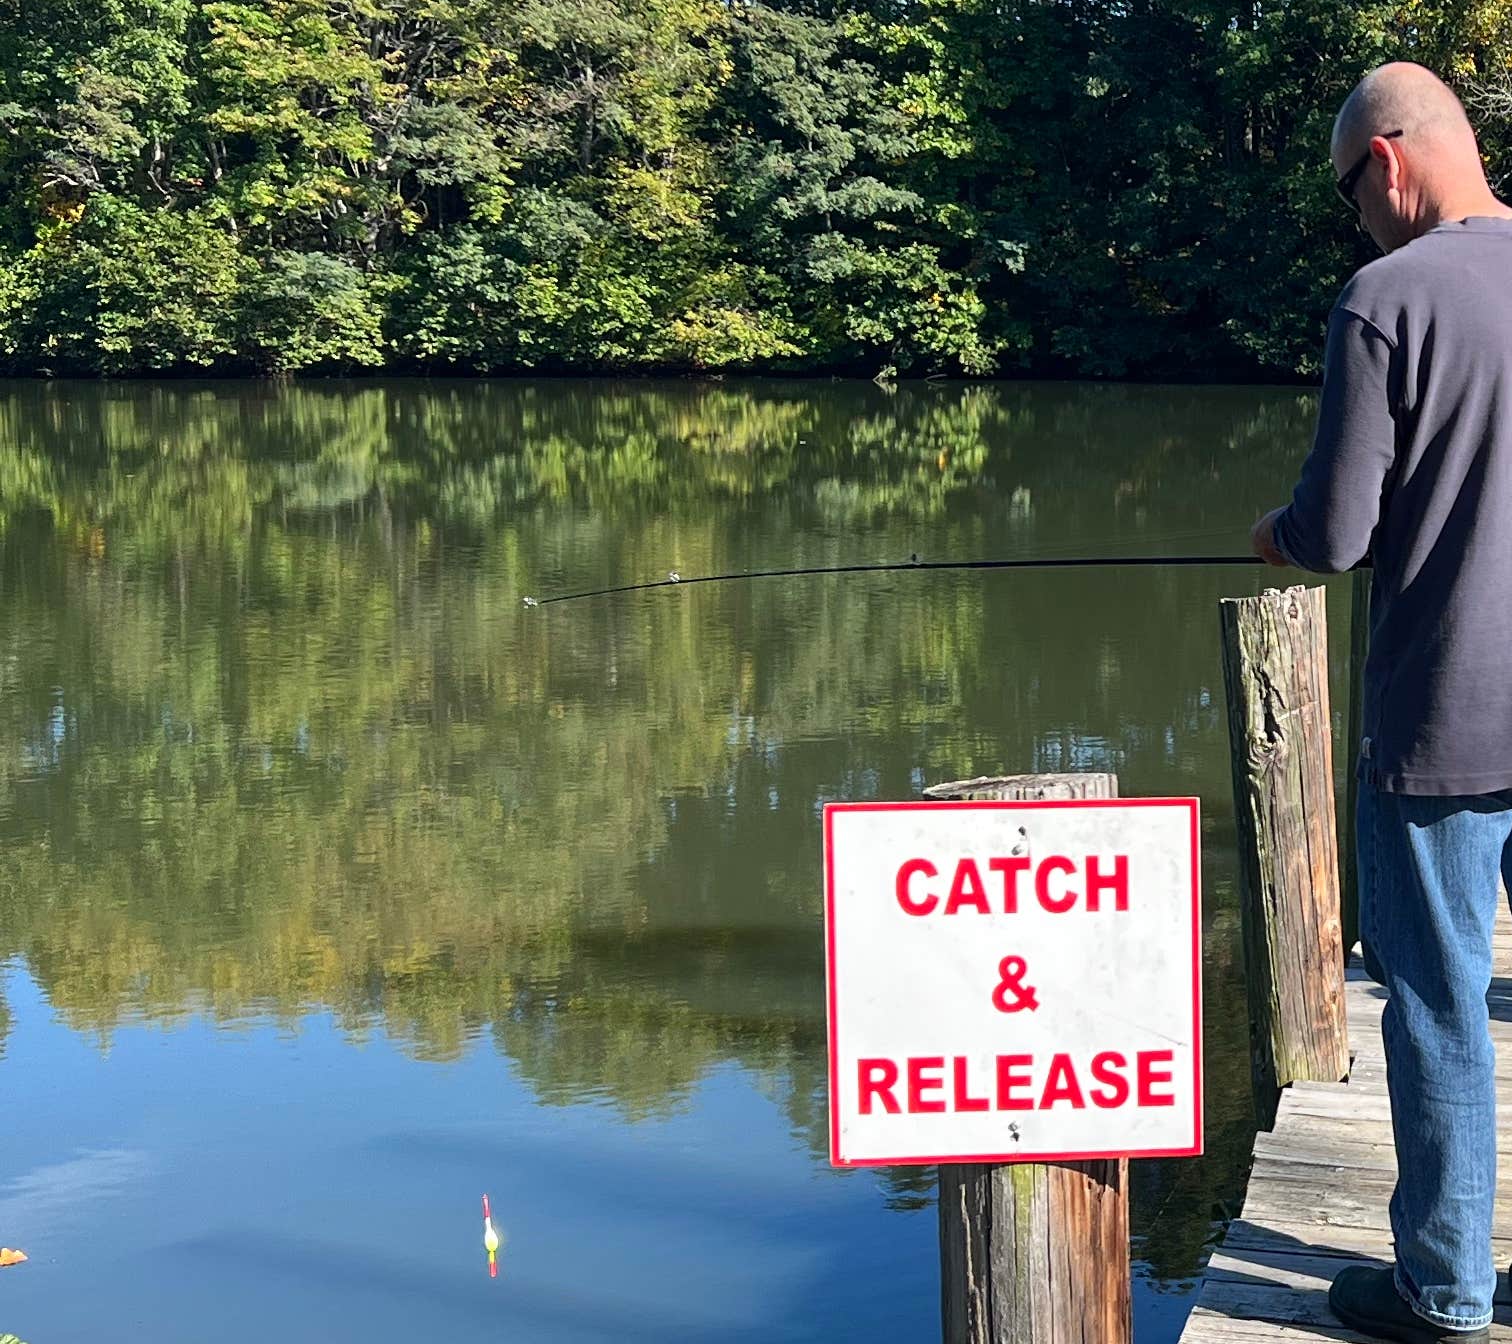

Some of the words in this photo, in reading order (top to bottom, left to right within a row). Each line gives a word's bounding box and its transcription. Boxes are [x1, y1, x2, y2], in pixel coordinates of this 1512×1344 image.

[895, 855, 1130, 916] CATCH
[991, 955, 1040, 1014] &
[857, 1049, 1176, 1116] RELEASE
